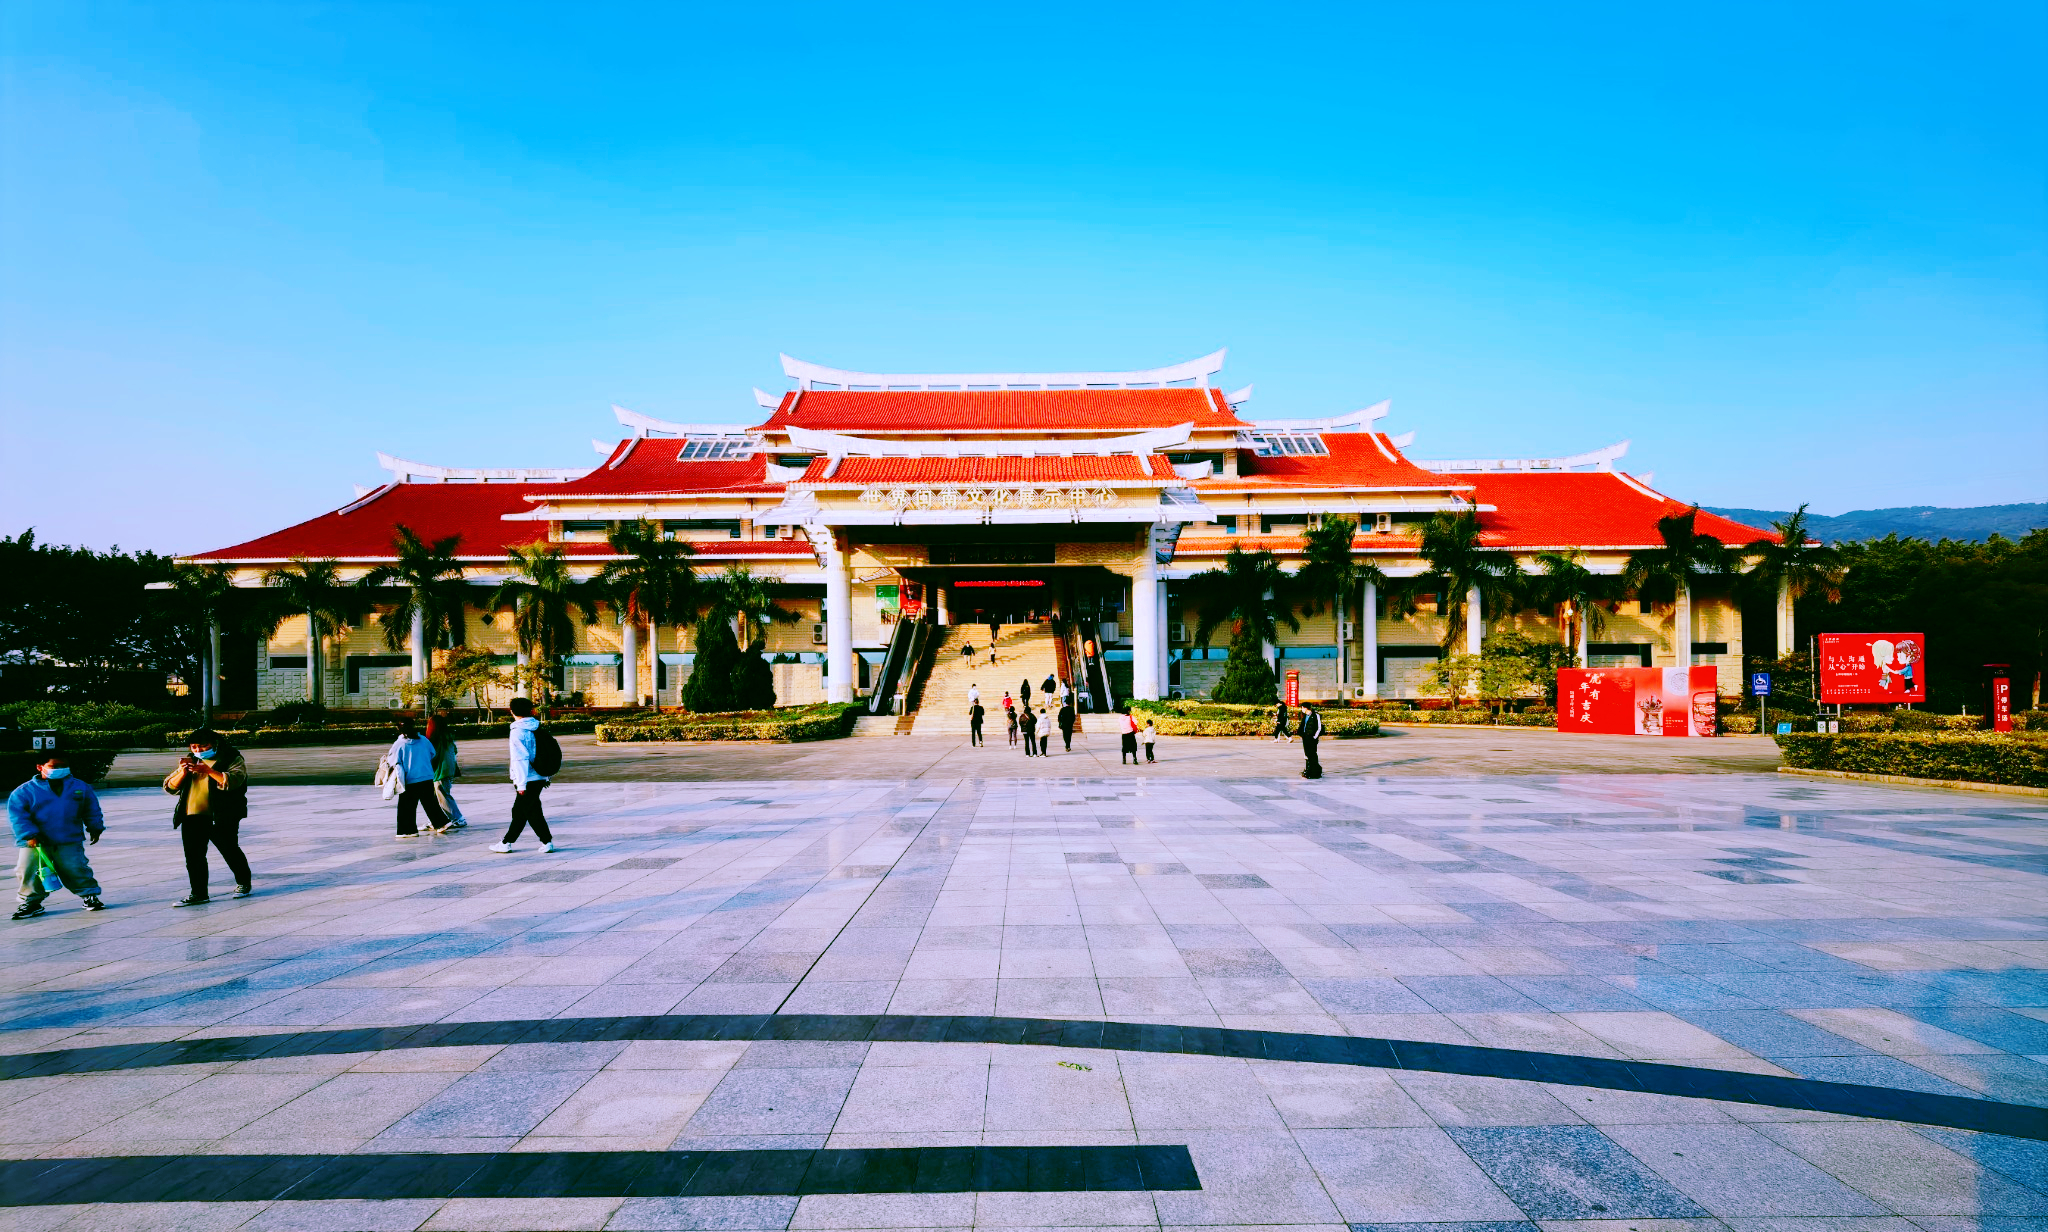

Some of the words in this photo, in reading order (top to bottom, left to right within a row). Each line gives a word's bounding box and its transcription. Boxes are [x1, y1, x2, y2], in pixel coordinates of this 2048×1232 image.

[865, 487, 1112, 505] 世界闽南文化展示中心
[1828, 655, 1866, 663] 与人沟通
[2000, 684, 2008, 693] P
[2000, 696, 2008, 722] 停车场
